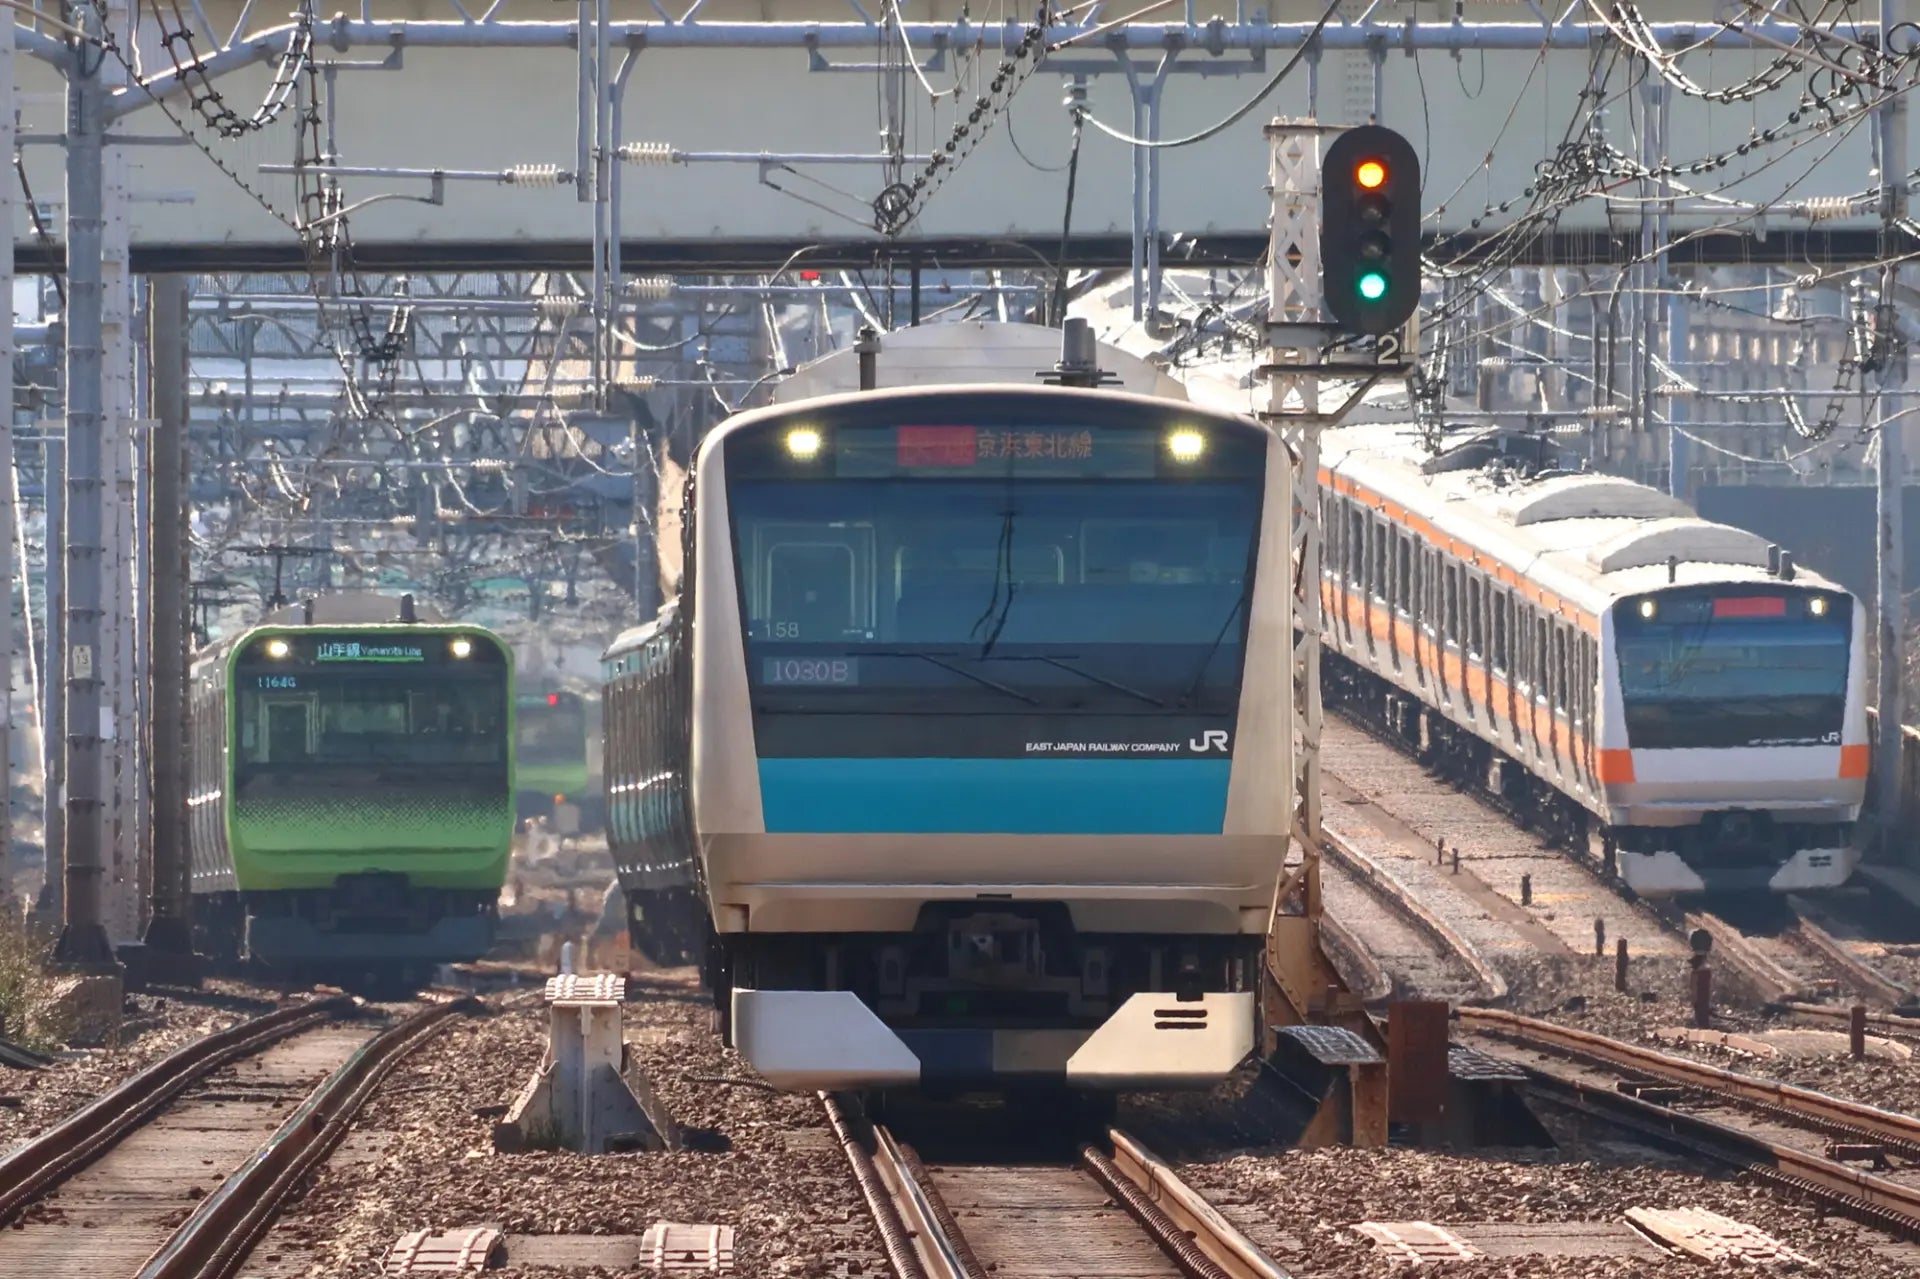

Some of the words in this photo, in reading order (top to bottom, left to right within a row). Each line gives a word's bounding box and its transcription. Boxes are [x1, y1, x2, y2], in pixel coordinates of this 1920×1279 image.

[1377, 334, 1399, 365] 2
[976, 430, 1092, 459] 京浜東北線
[765, 621, 799, 638] 158
[318, 642, 360, 657] 山手線
[773, 660, 848, 681] 1030B
[1025, 742, 1052, 752] EAST
[1053, 742, 1087, 752] JAPAN
[1088, 742, 1130, 752] RAILWAY
[1131, 742, 1180, 752] COMPANY
[1189, 730, 1229, 752] JR
[1821, 732, 1840, 743] JR
